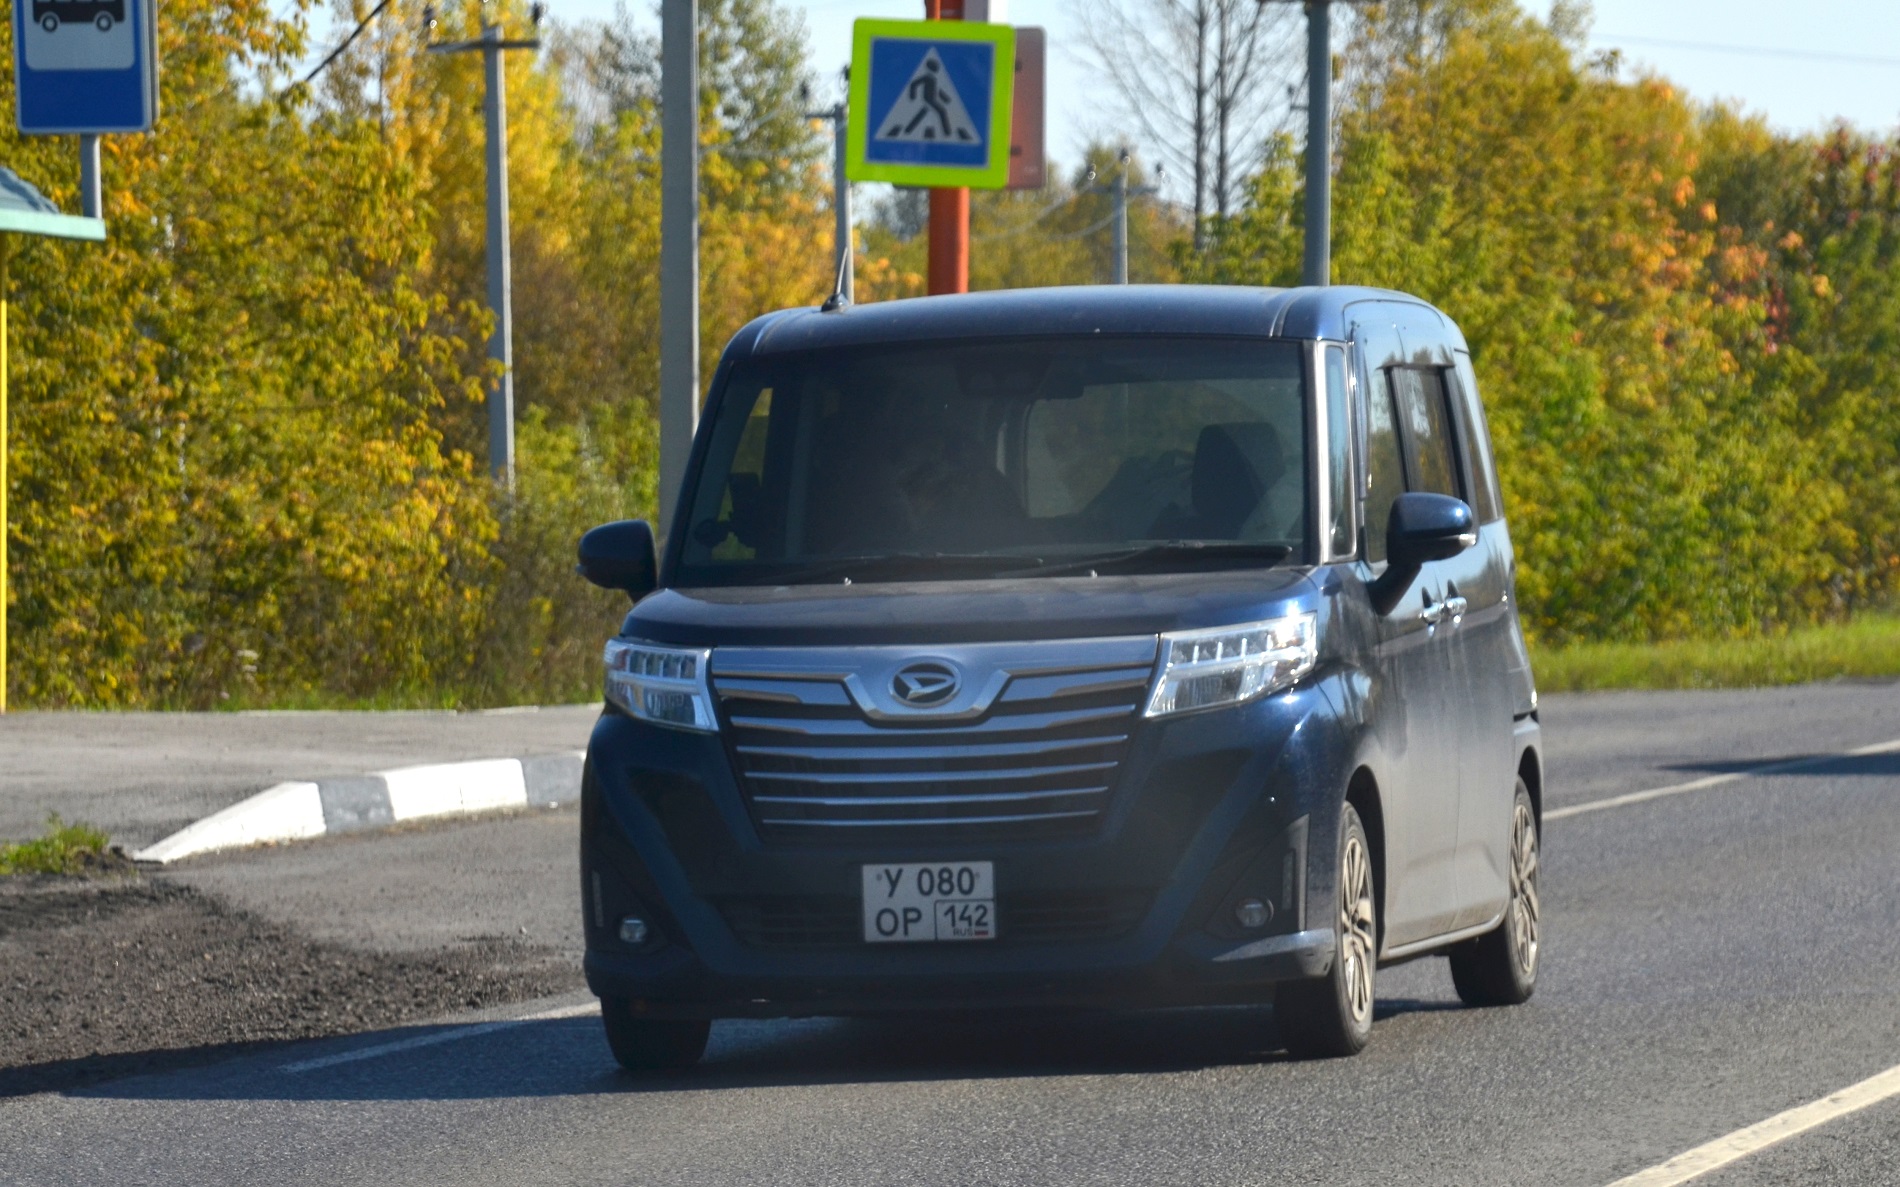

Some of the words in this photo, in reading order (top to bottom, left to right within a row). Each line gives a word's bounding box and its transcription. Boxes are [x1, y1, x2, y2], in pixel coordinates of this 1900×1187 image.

[917, 867, 975, 896] 080
[944, 904, 988, 927] 142
[953, 928, 973, 936] RUS
